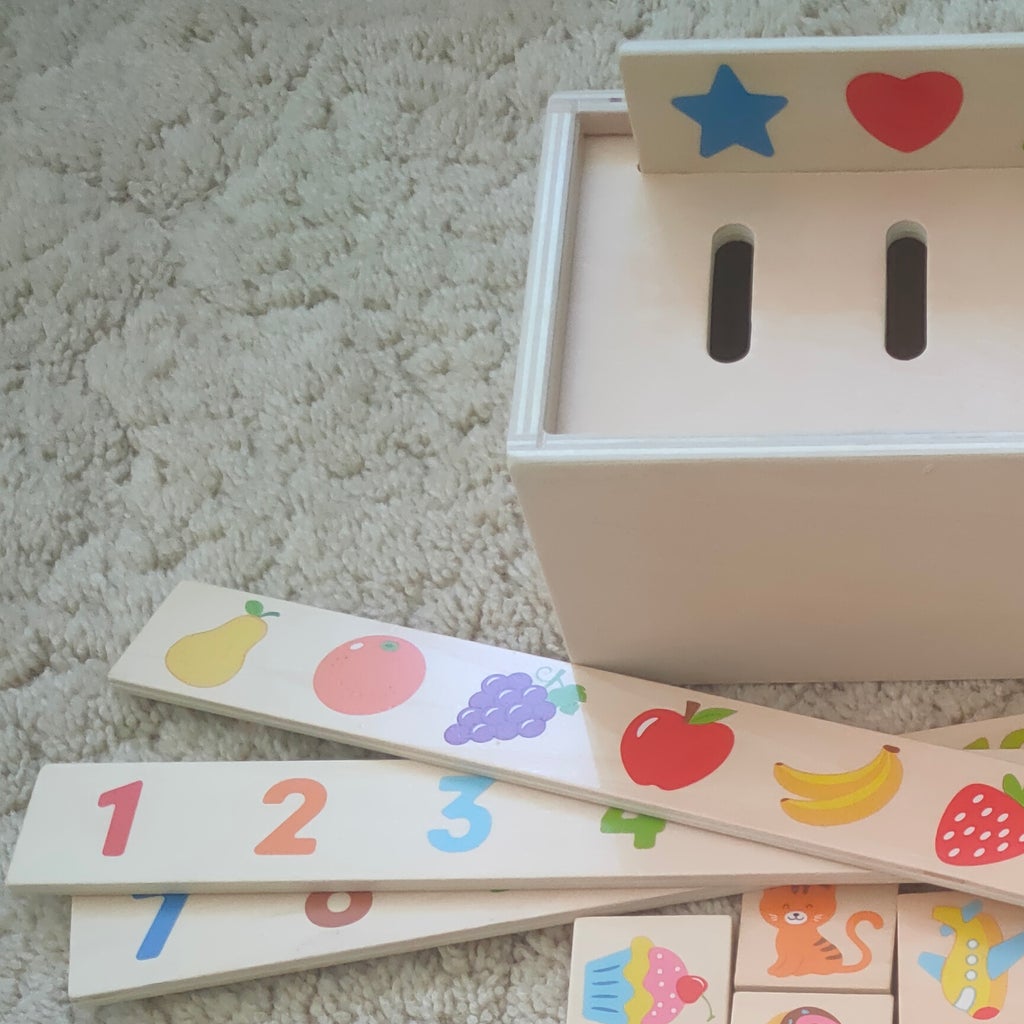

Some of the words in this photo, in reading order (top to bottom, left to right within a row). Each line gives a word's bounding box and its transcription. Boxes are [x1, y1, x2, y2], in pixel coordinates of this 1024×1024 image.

[98, 780, 143, 857] 1
[254, 778, 328, 856] 2
[426, 776, 494, 853] 3
